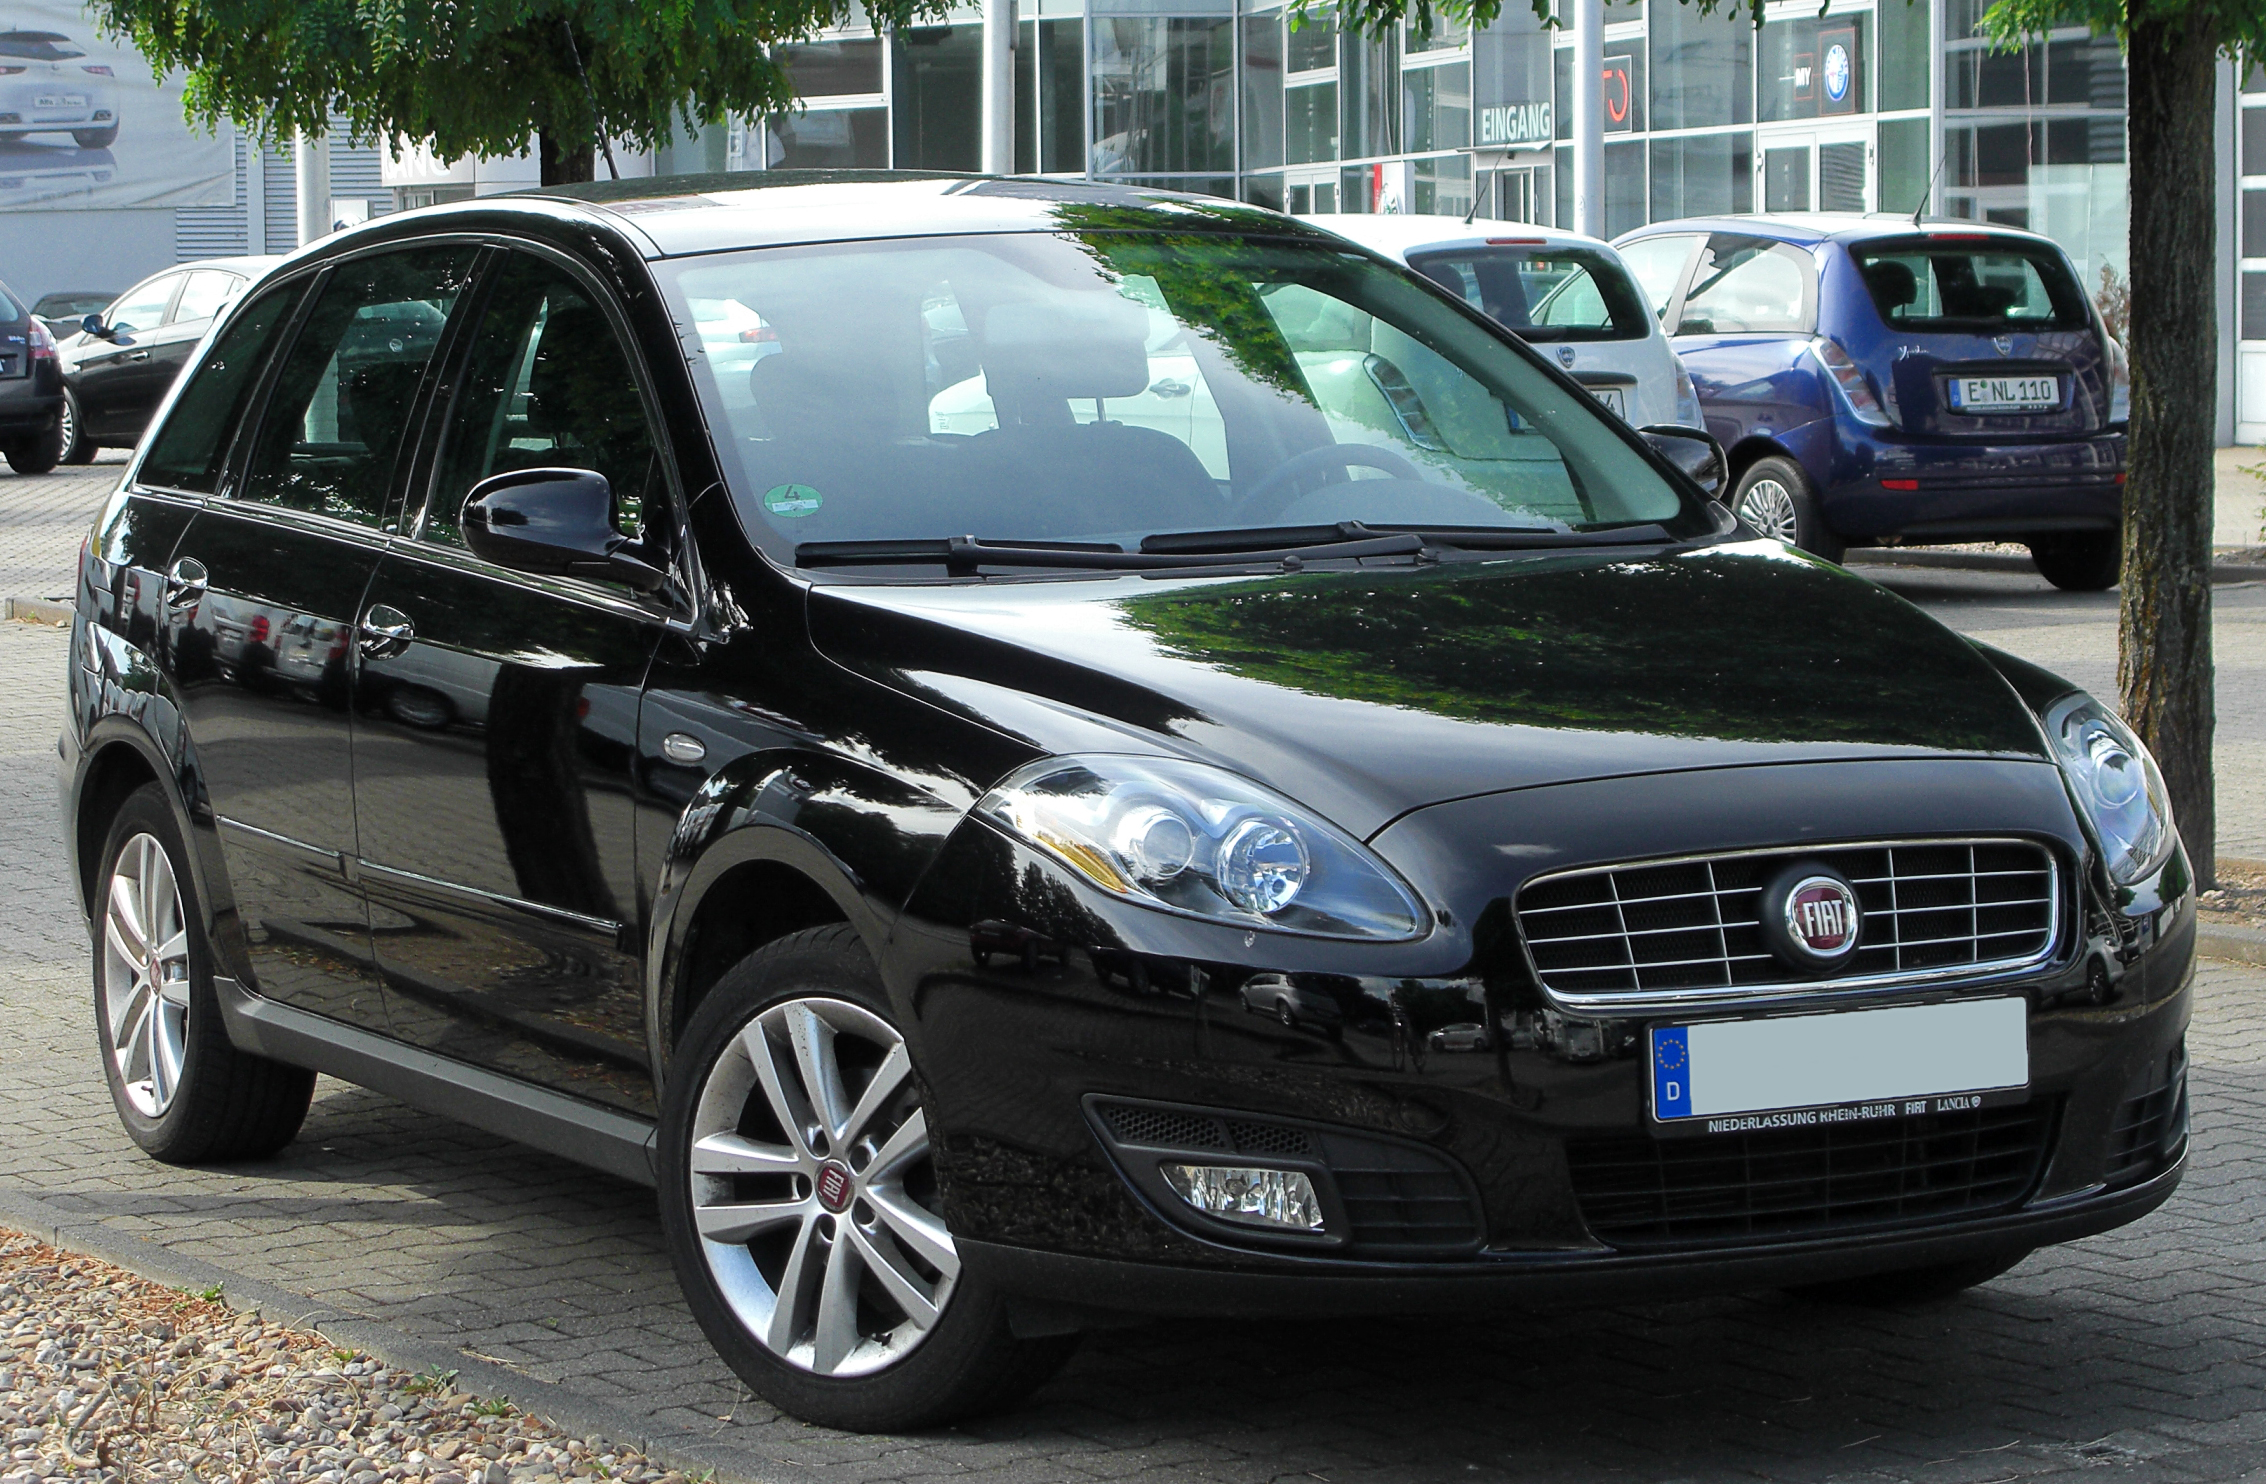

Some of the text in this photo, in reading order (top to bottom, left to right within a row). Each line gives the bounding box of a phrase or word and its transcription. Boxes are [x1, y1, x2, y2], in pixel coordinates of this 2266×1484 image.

[1482, 102, 1550, 142] EINGANG
[1968, 380, 2051, 402] E NL 110
[784, 485, 801, 500] 4
[1802, 899, 1844, 938] FIAT
[1667, 1081, 1680, 1101] D
[1708, 1096, 1971, 1133] NIEDERLASSUNG RHEIN-RUHR FIAT LANCIA
[823, 1169, 845, 1203] FIAT
